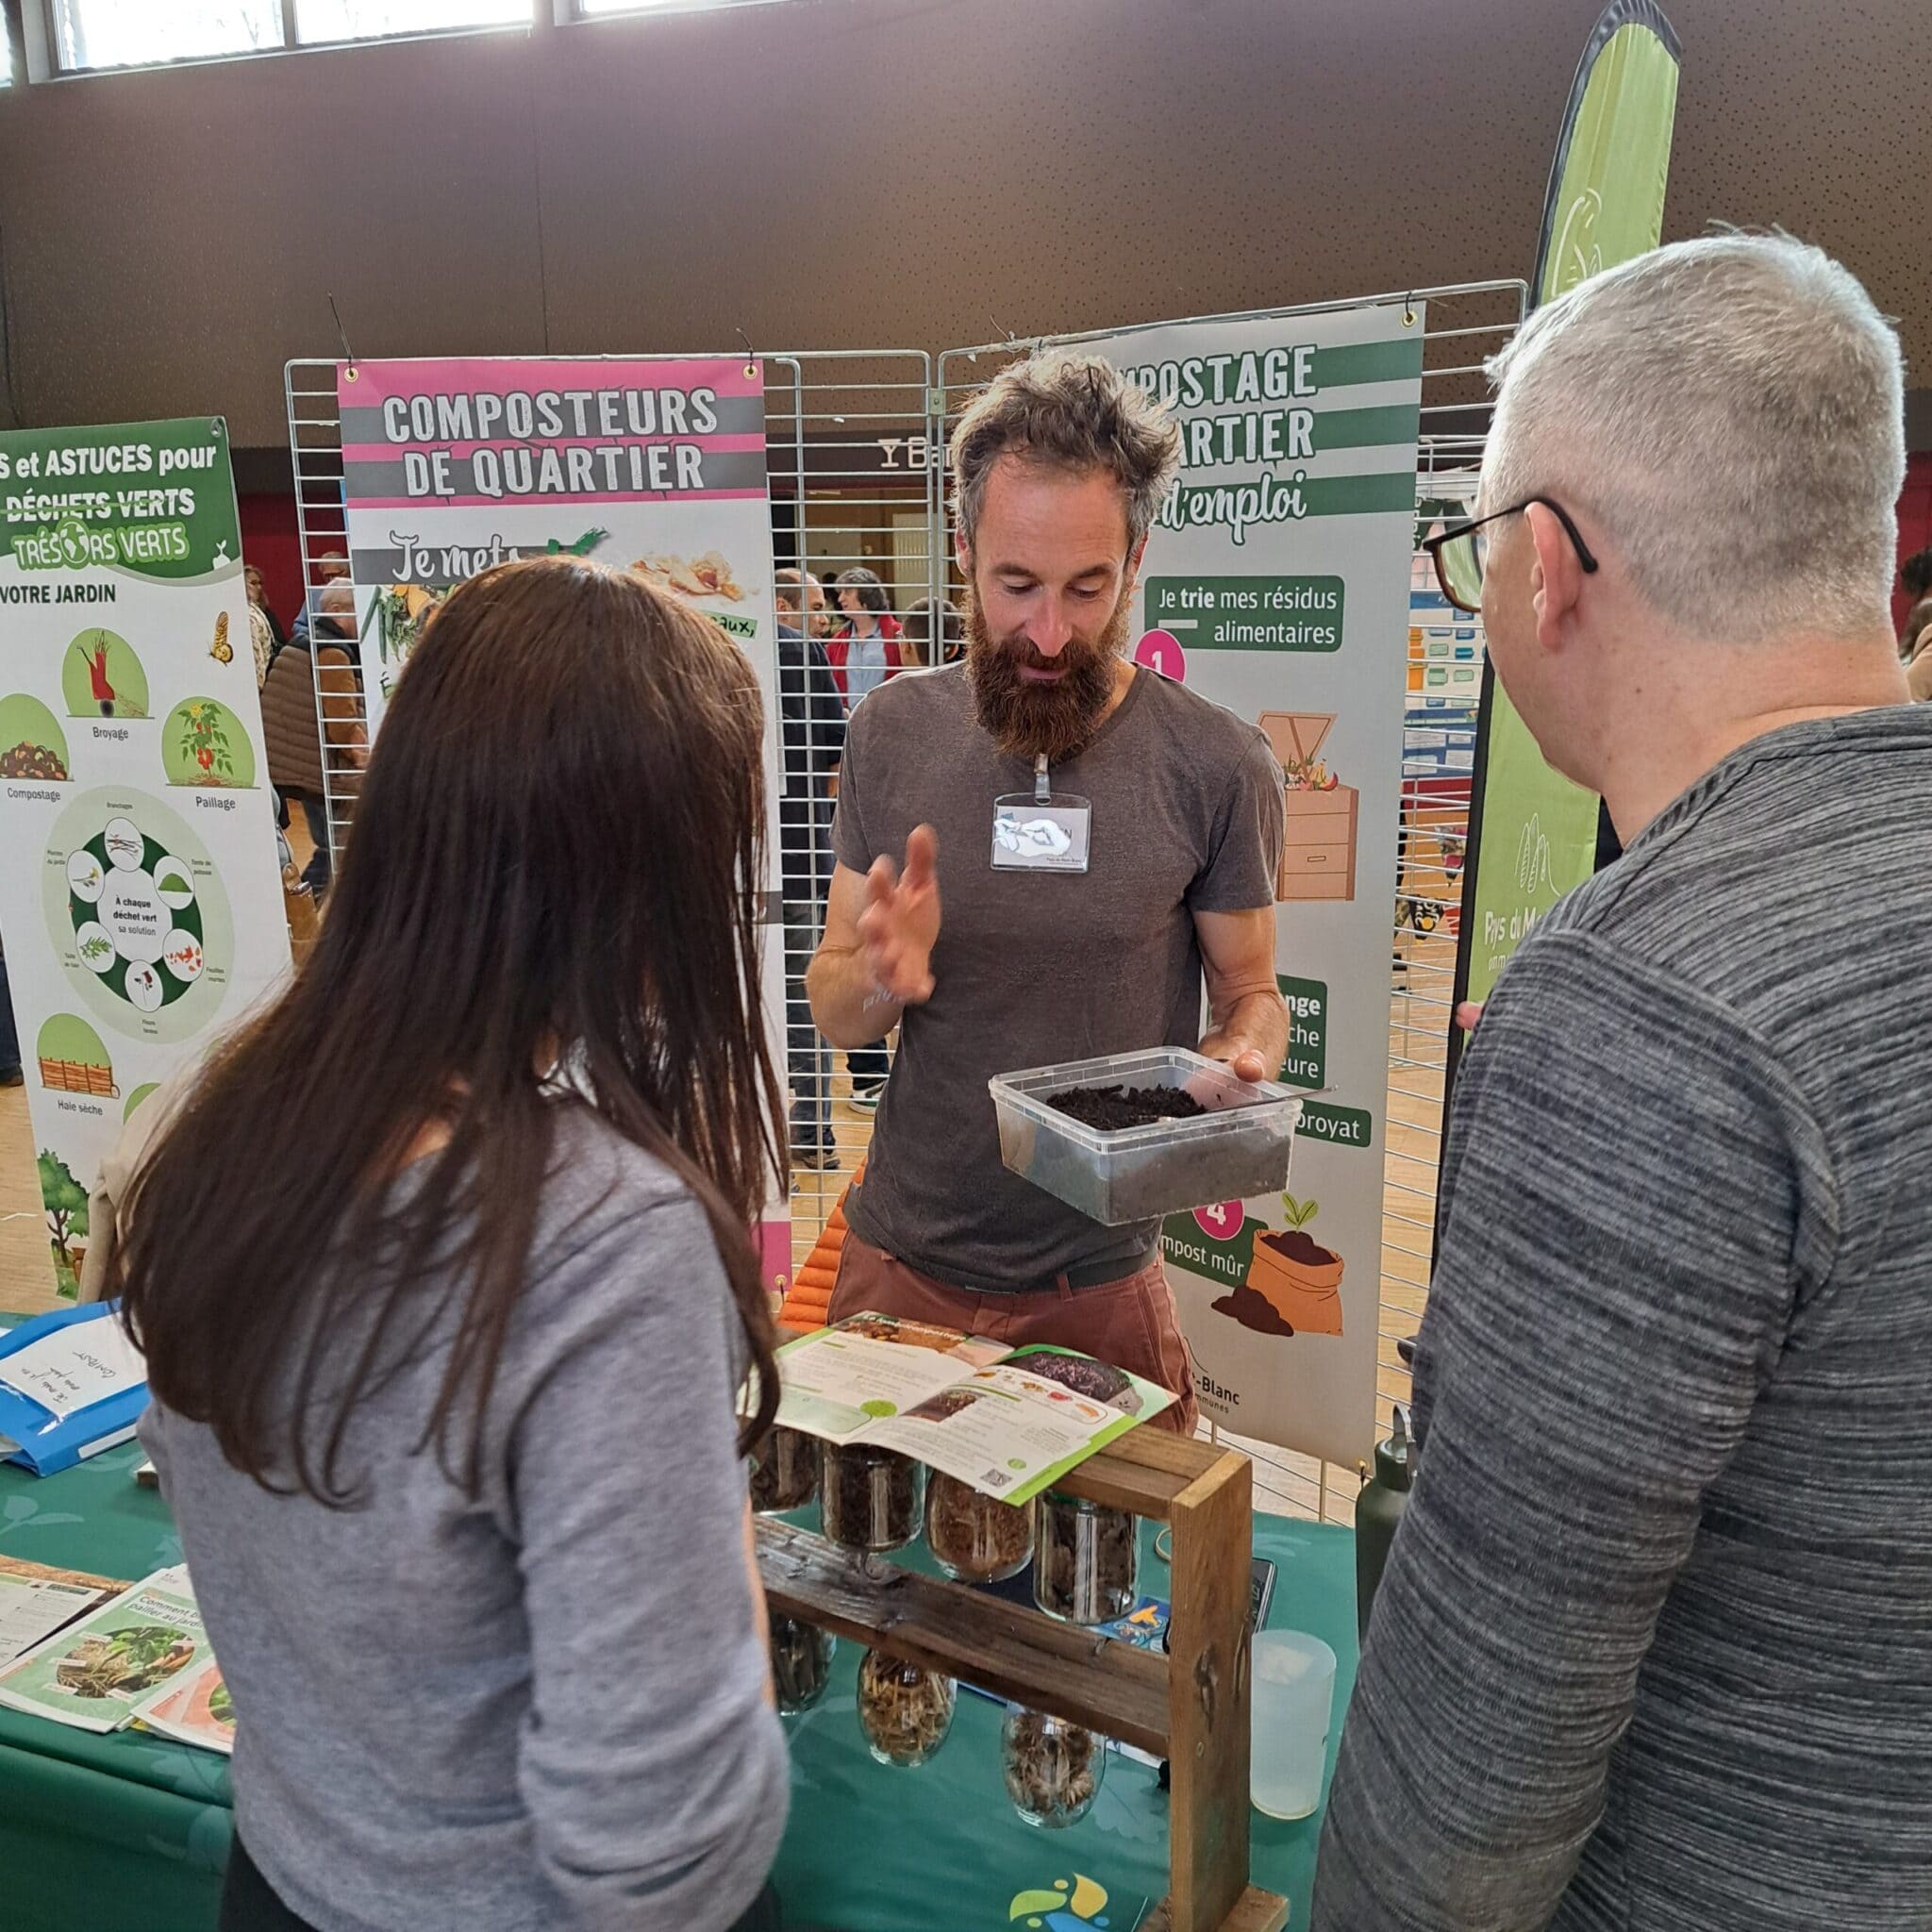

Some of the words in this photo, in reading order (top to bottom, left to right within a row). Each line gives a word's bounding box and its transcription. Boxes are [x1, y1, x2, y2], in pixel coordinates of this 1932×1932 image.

[382, 388, 718, 443] COMPOSTEURS
[15, 451, 40, 478] et
[44, 443, 153, 477] ASTUCES
[158, 444, 217, 476] pour
[402, 450, 456, 496] DE
[473, 443, 705, 498] QUARTIER
[6, 487, 112, 523] DÉCHETS
[116, 487, 195, 518] VERTS
[1160, 471, 1308, 545] d'emploi
[120, 524, 187, 560] VERTS
[389, 529, 435, 582] Je
[0, 585, 51, 605] VOTRE
[55, 583, 116, 604] JARDIN
[1158, 587, 1176, 608] Je
[1180, 588, 1215, 608] trie
[1220, 591, 1258, 608] mes
[1263, 585, 1338, 609] résidus
[1214, 620, 1336, 644] alimentaires
[92, 725, 129, 741] Broyage
[7, 787, 61, 803] Compostage
[195, 796, 236, 811] Paillage
[123, 897, 151, 908] chaque
[112, 909, 140, 921] déchet
[142, 913, 157, 923] vert
[127, 925, 157, 936] solution
[1285, 994, 1321, 1018] nge
[1289, 1023, 1320, 1047] che
[57, 1099, 77, 1113] Haie
[78, 1101, 104, 1116] sèche
[1207, 1203, 1227, 1225] 4
[1161, 1234, 1208, 1266] mpost
[1211, 1253, 1245, 1278] mûr
[1191, 1372, 1241, 1406] -Blanc
[127, 1603, 162, 1617] pailler
[139, 1595, 190, 1616] Comment
